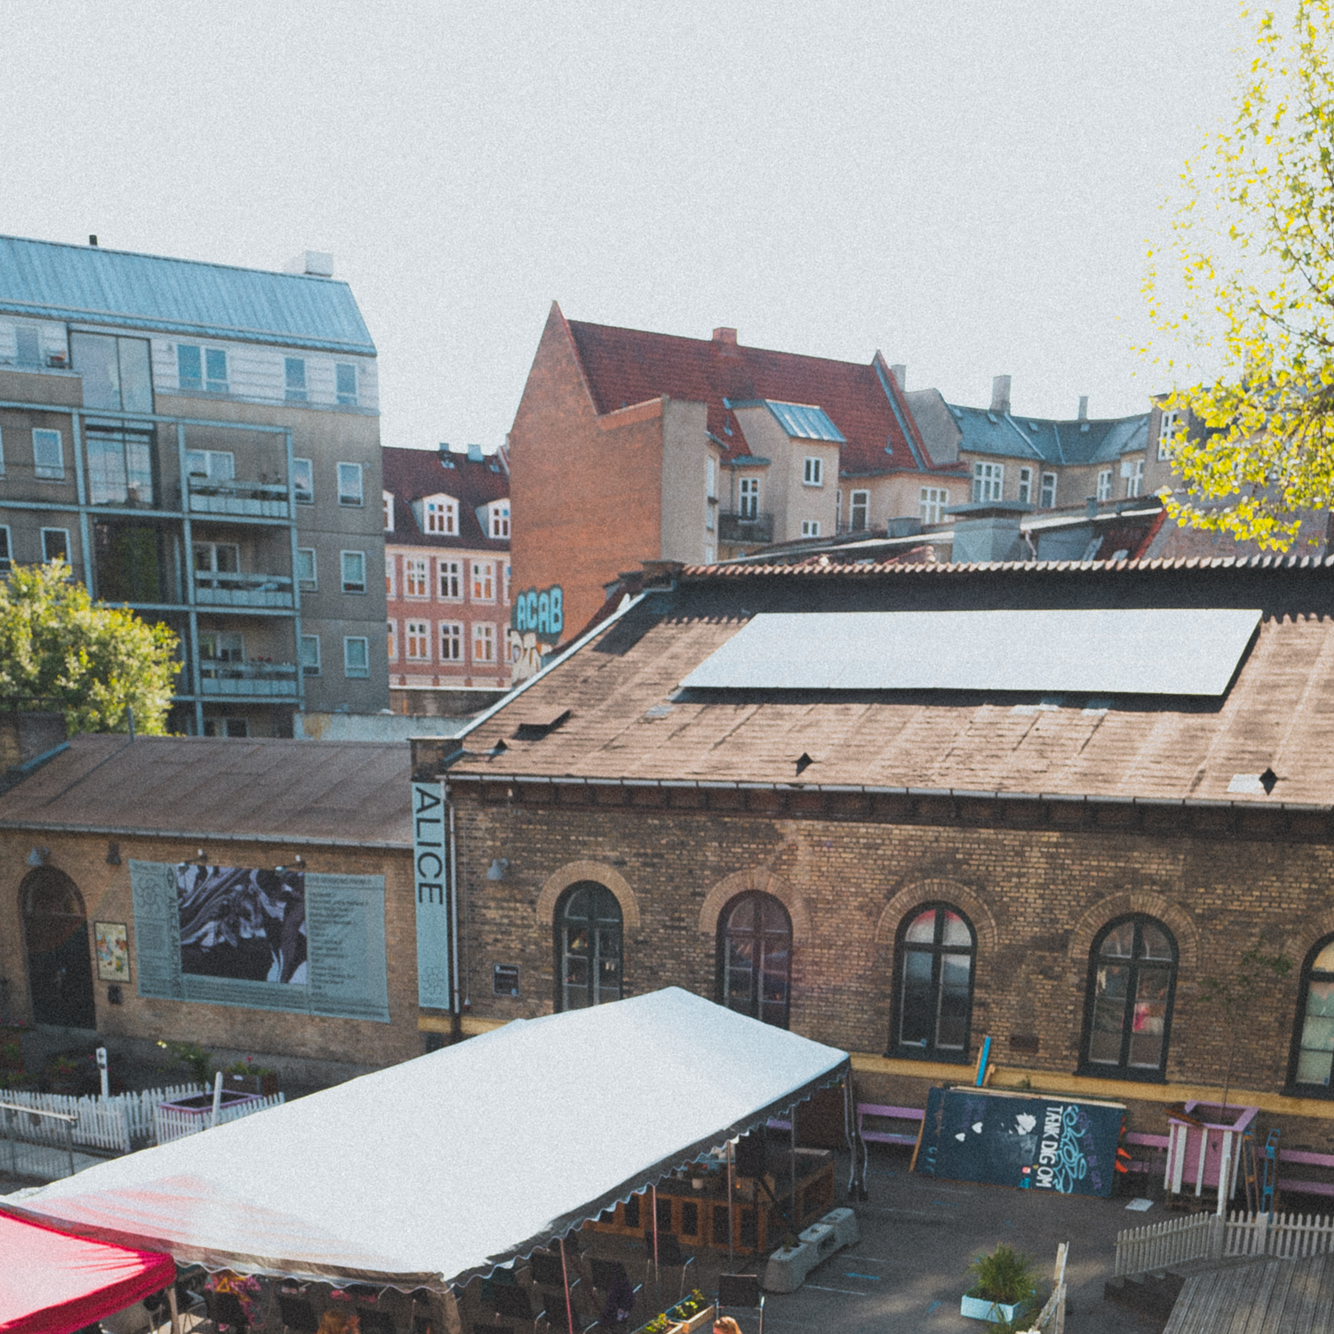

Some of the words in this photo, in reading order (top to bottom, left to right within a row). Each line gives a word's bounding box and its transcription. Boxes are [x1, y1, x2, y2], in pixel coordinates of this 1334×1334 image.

[516, 587, 563, 634] ACAB
[415, 786, 444, 906] ALICE
[1042, 1105, 1063, 1144] TÆNK
[1038, 1141, 1059, 1165] DIG
[1035, 1167, 1054, 1189] OM
